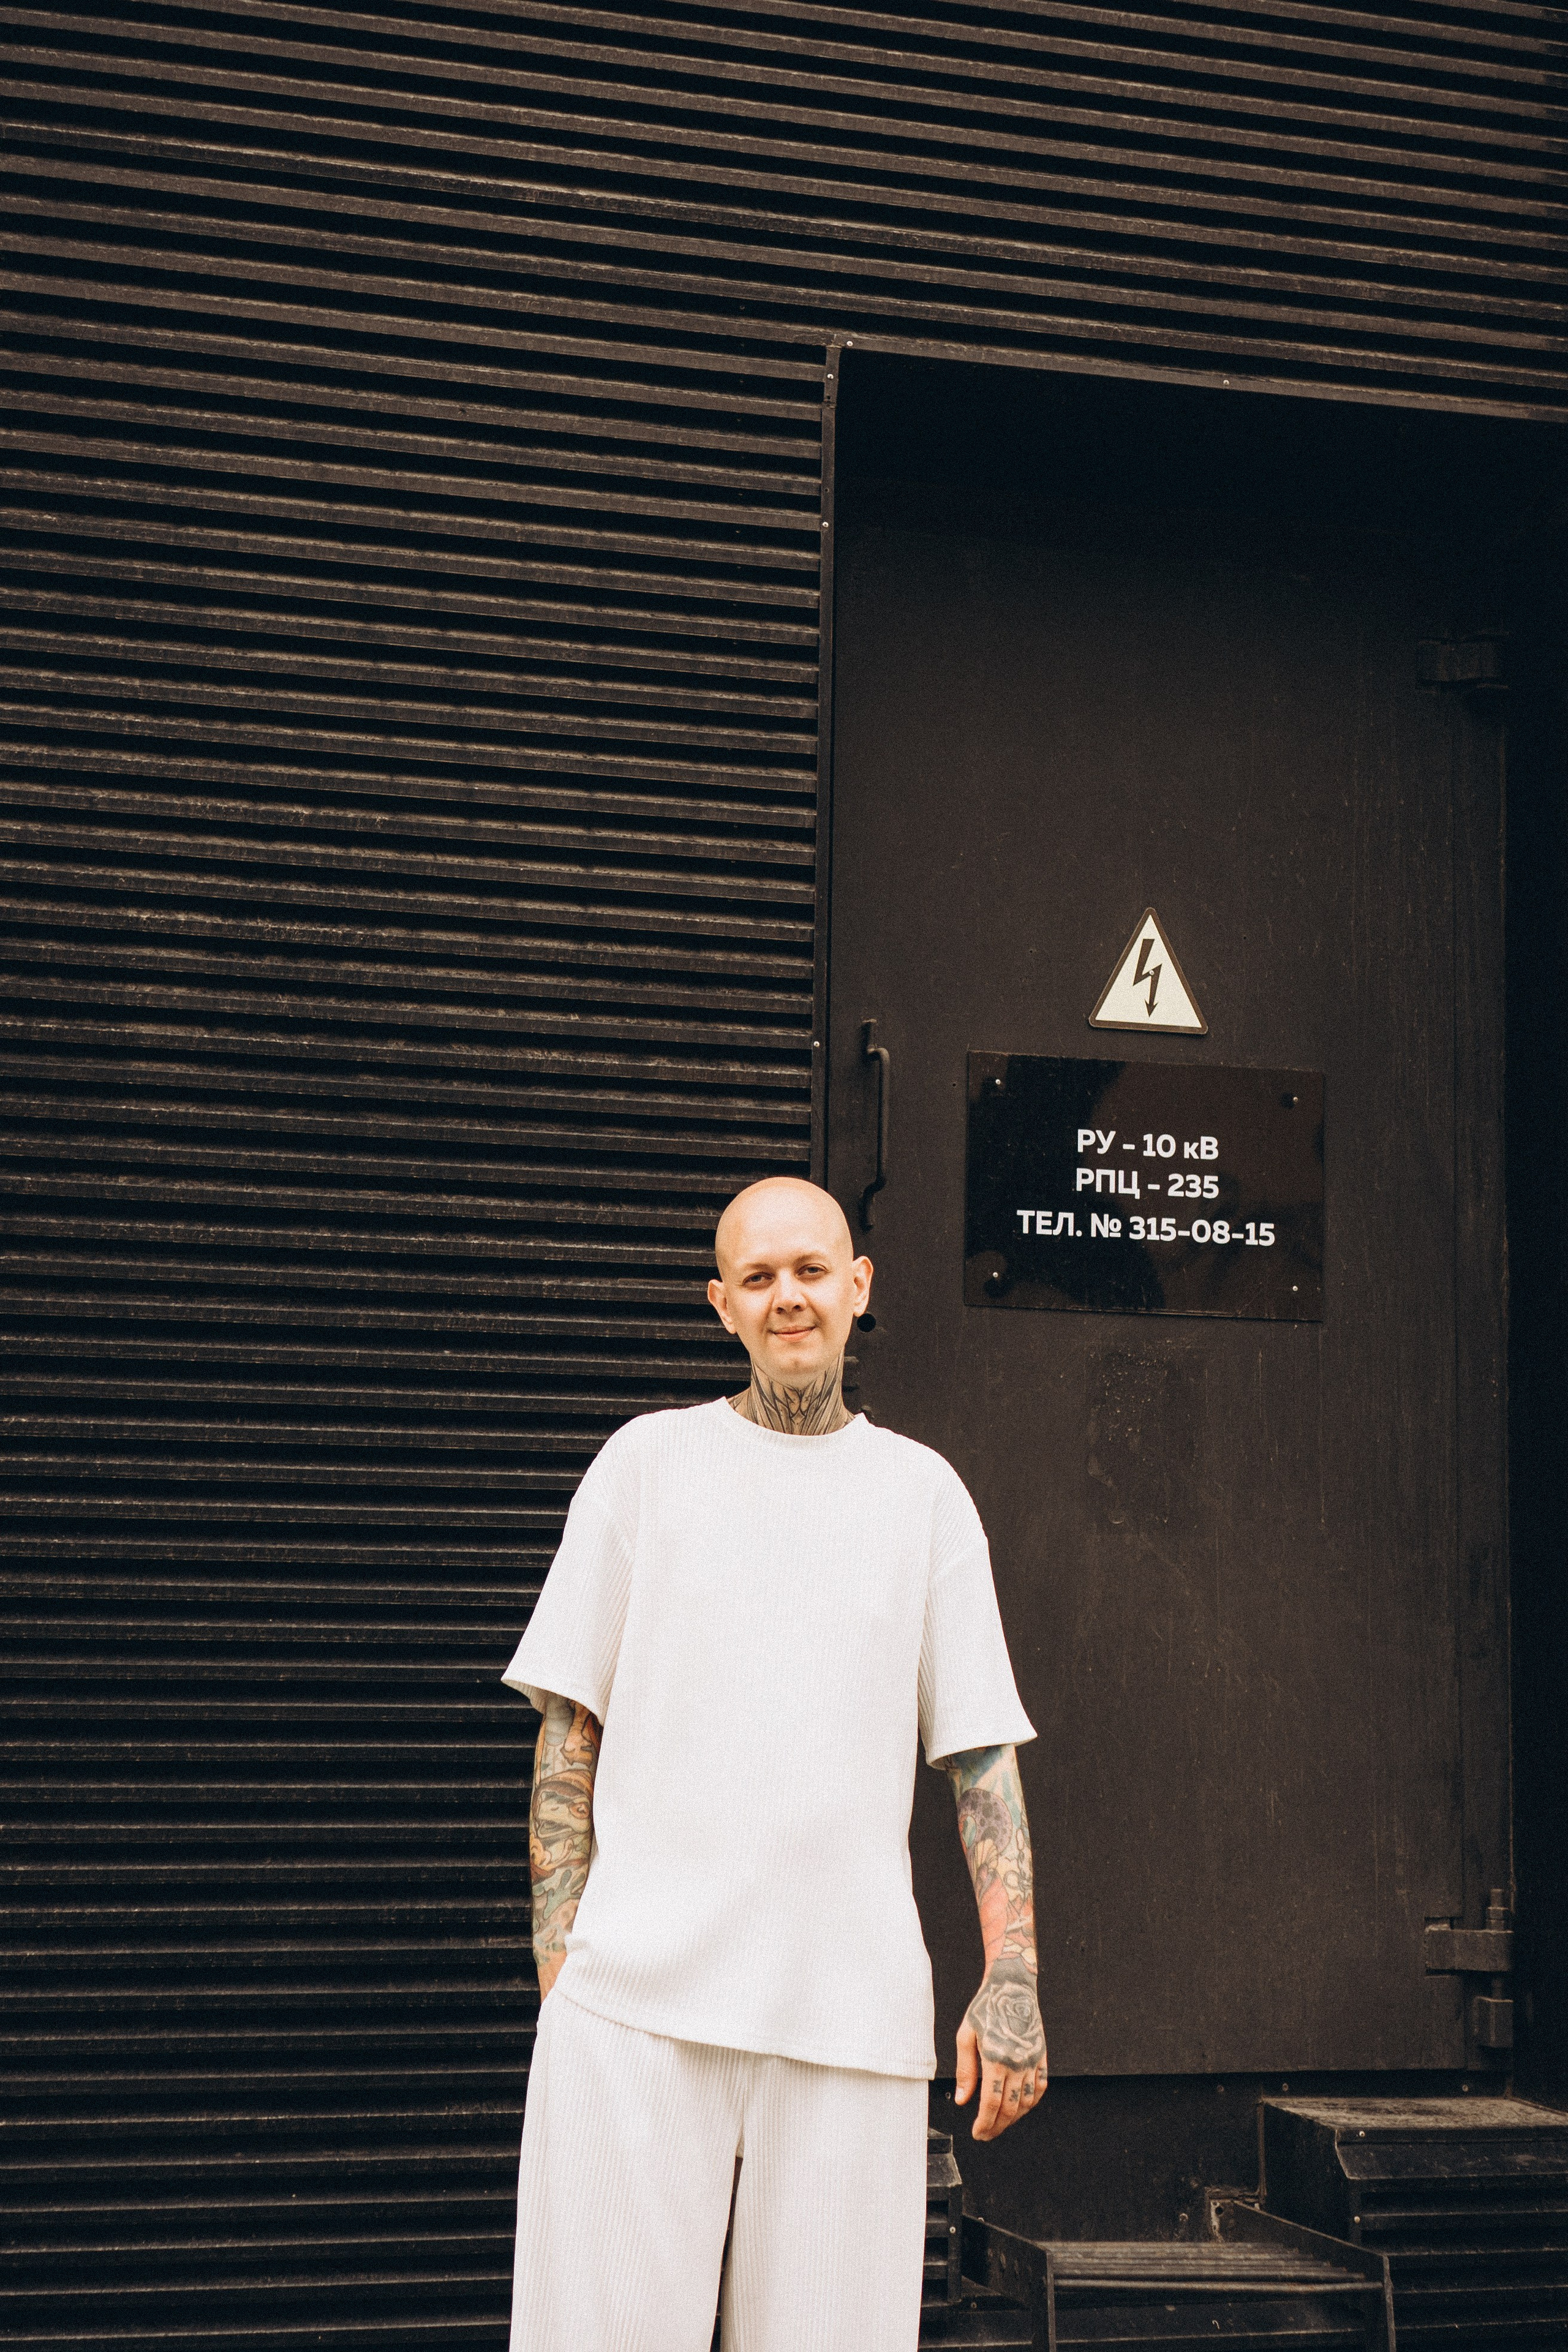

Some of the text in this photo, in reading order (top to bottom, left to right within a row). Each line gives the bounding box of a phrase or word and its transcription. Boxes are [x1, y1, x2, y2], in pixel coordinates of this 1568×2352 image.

[1077, 1128, 1117, 1155] РУ
[1142, 1133, 1176, 1158] 10
[1183, 1136, 1219, 1160] кВ
[1076, 1167, 1140, 1200] РПЦ
[1167, 1173, 1219, 1199] 235
[1016, 1209, 1275, 1246] ТЕЛ. № 315-08-15
